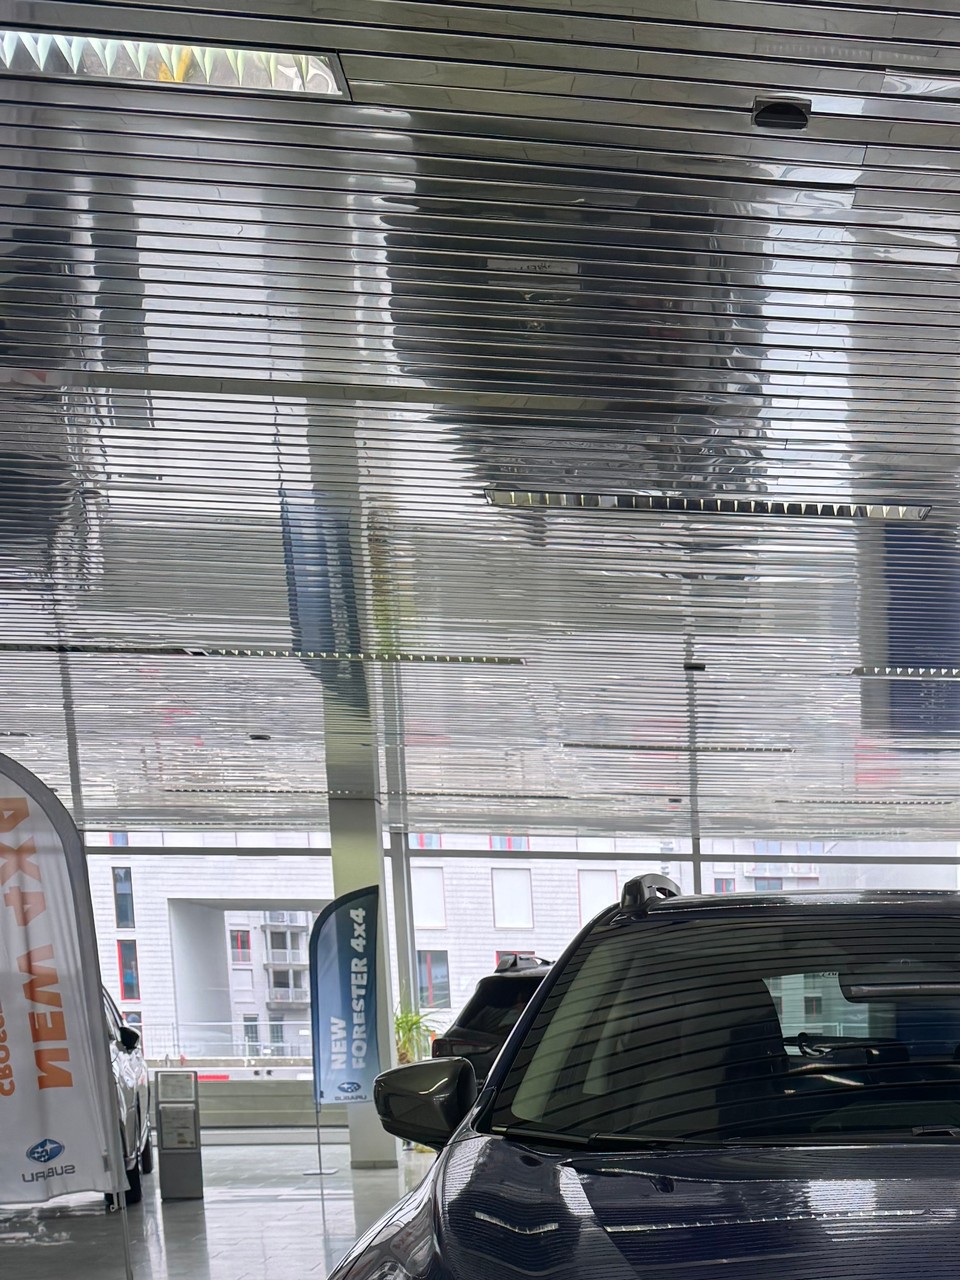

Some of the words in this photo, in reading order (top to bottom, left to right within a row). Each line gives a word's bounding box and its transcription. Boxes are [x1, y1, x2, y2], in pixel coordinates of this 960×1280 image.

[350, 907, 367, 954] 4x4
[351, 957, 368, 1070] FORESTER
[330, 1017, 347, 1070] NEW
